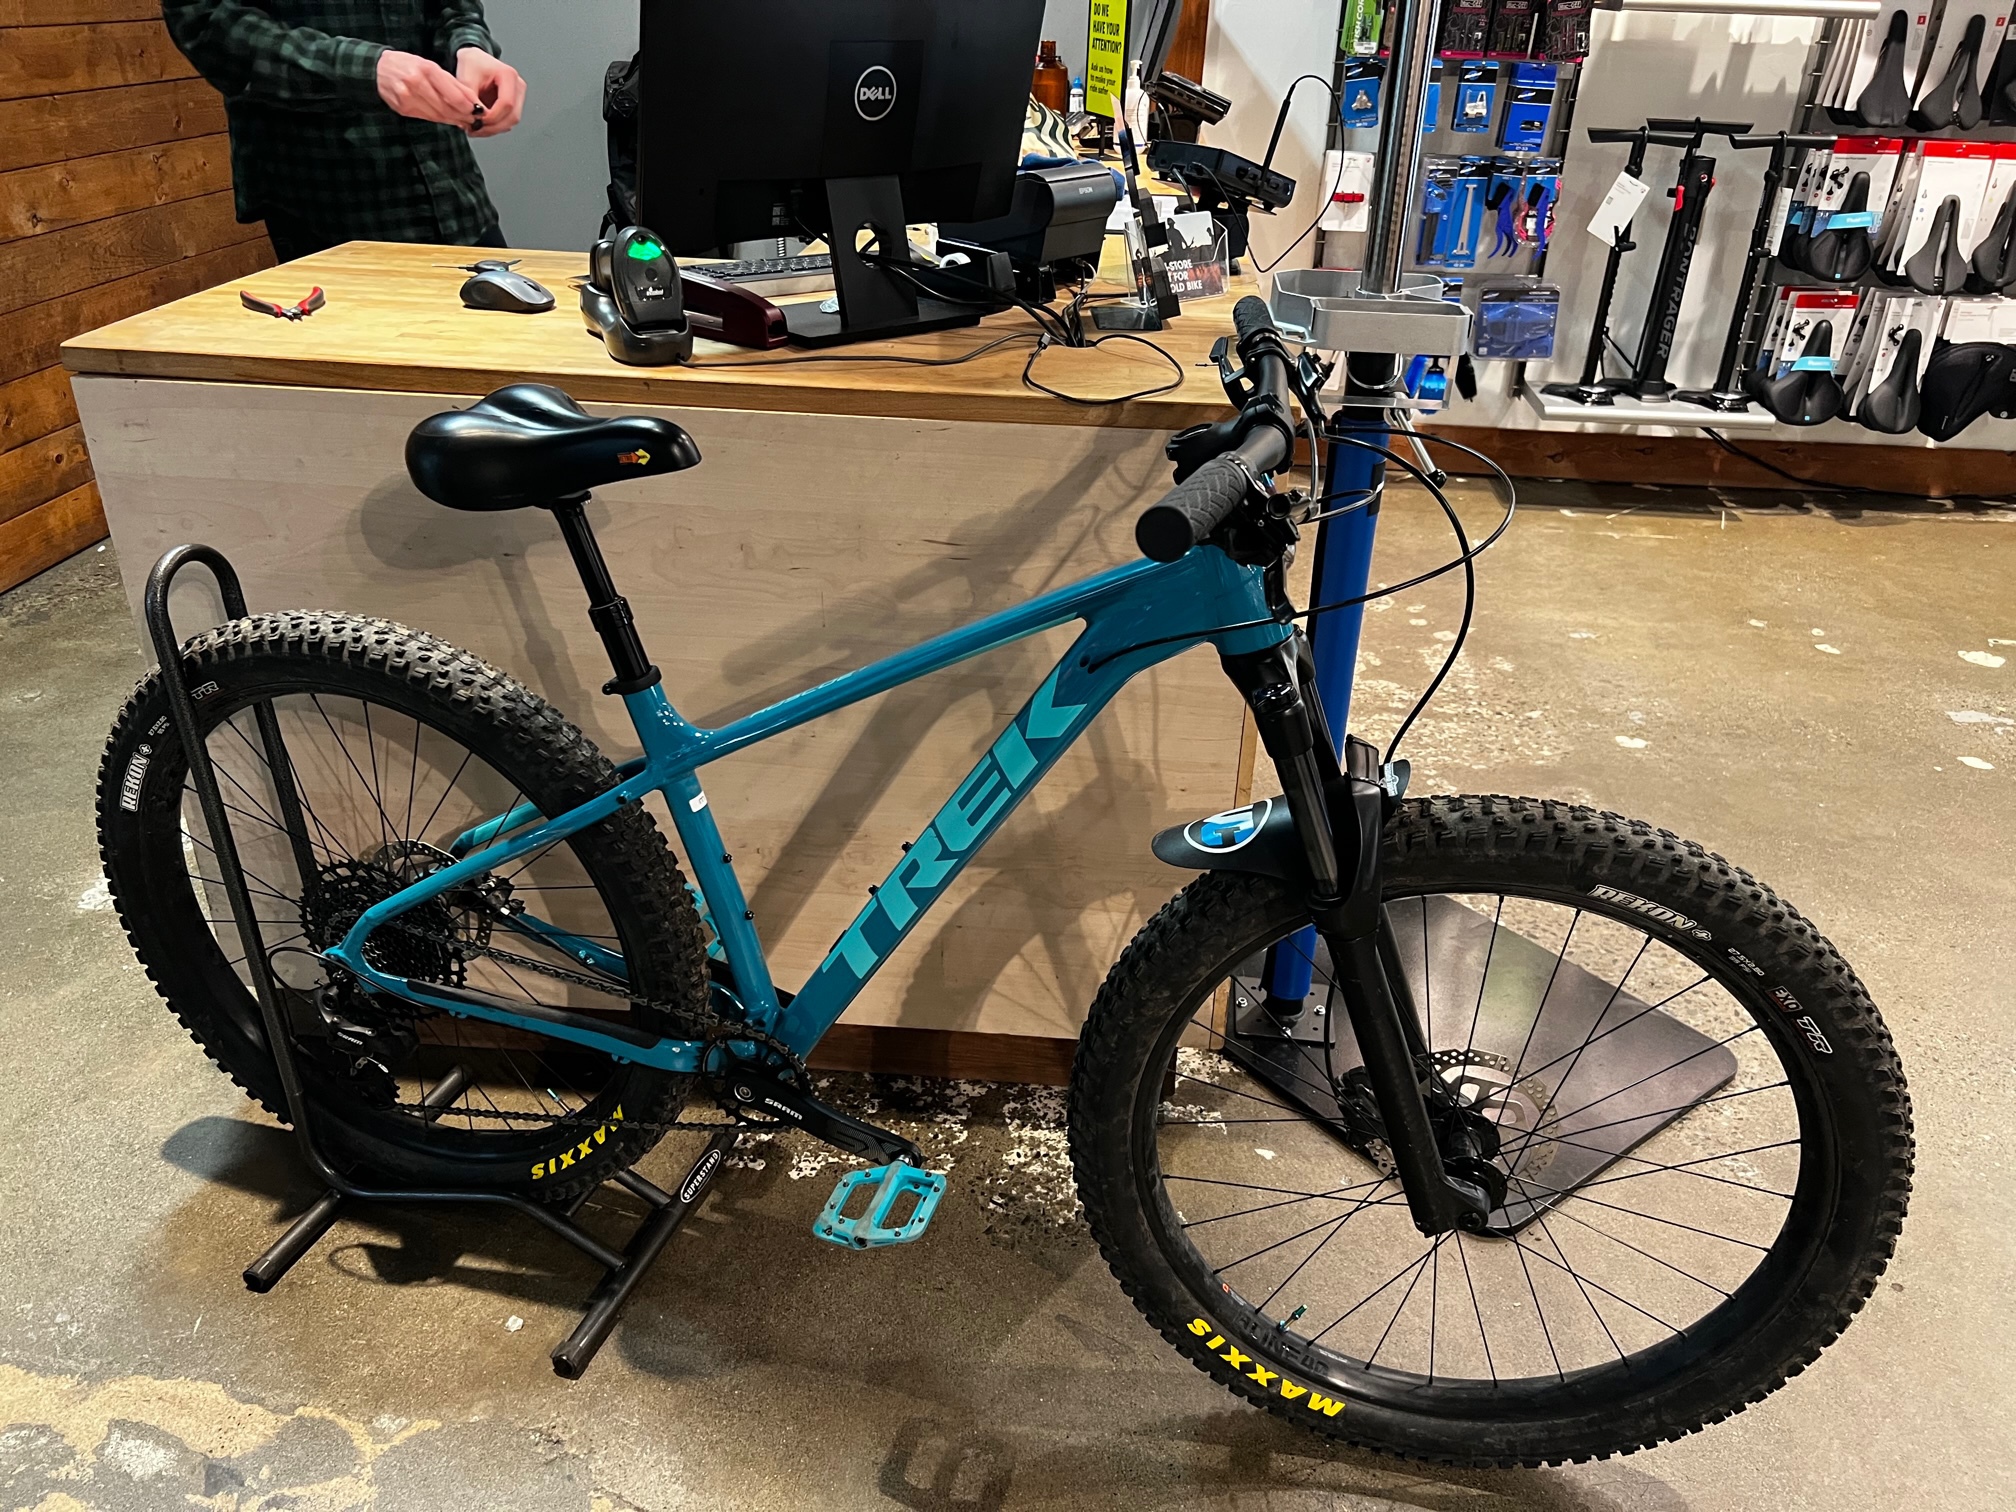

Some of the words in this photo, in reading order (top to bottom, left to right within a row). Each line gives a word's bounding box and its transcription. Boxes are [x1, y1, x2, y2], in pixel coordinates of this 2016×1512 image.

[1093, 3, 1101, 17] DO
[1101, 4, 1109, 17] WE
[1092, 20, 1106, 34] HAVE
[1106, 22, 1120, 36] YOUR
[1091, 37, 1122, 54] ATTENTION?
[1090, 62, 1099, 72] Ask
[1098, 65, 1104, 73] us
[1104, 66, 1113, 74] how
[1089, 84, 1097, 93] ride
[1097, 86, 1109, 95] safer
[1094, 75, 1106, 84] make
[1105, 78, 1116, 87] your
[859, 86, 892, 101] DELL
[1173, 271, 1189, 282] FOR
[1186, 280, 1203, 291] BIKE
[190, 680, 220, 700] TR
[822, 664, 1087, 980] TREK
[1772, 985, 1802, 1013] EXO
[1796, 1016, 1833, 1055] TR
[764, 1097, 803, 1121] SRAM
[530, 1103, 624, 1180] MAXXIS
[683, 1152, 719, 1200] SUPERSTAND
[1186, 1317, 1347, 1418] MAXXIS
